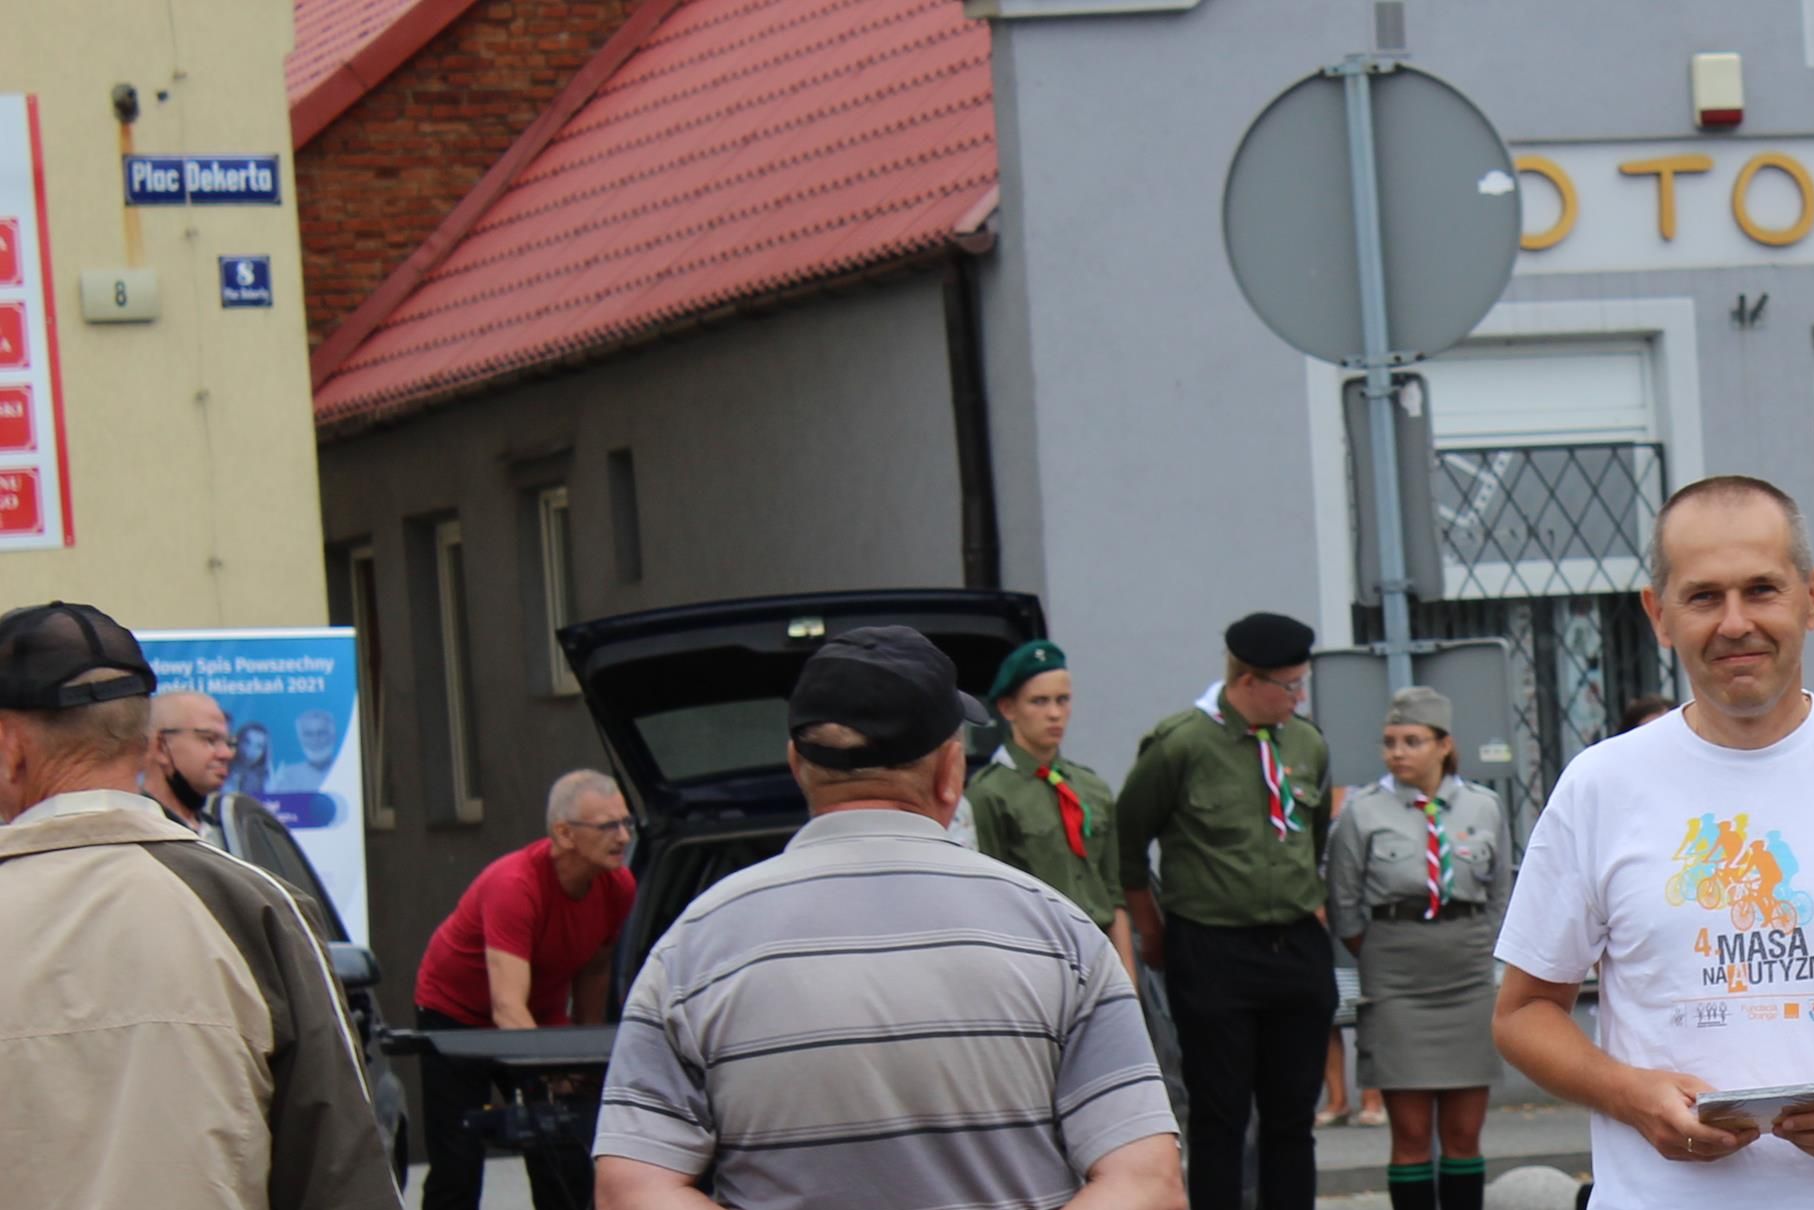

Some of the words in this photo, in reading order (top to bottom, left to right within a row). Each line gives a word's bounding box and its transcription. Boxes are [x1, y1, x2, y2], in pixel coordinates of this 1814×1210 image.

[132, 161, 180, 192] Plac
[187, 160, 273, 192] Dekerta
[236, 261, 255, 286] 8
[115, 280, 127, 307] 8
[150, 657, 193, 678] dowy
[196, 655, 233, 676] Spis
[235, 654, 336, 675] Powszechny
[207, 675, 285, 694] Mieszkań
[287, 676, 326, 693] 2021
[1694, 928, 1721, 957] 4.
[1717, 927, 1809, 966] MASA
[1703, 966, 1728, 986] NA
